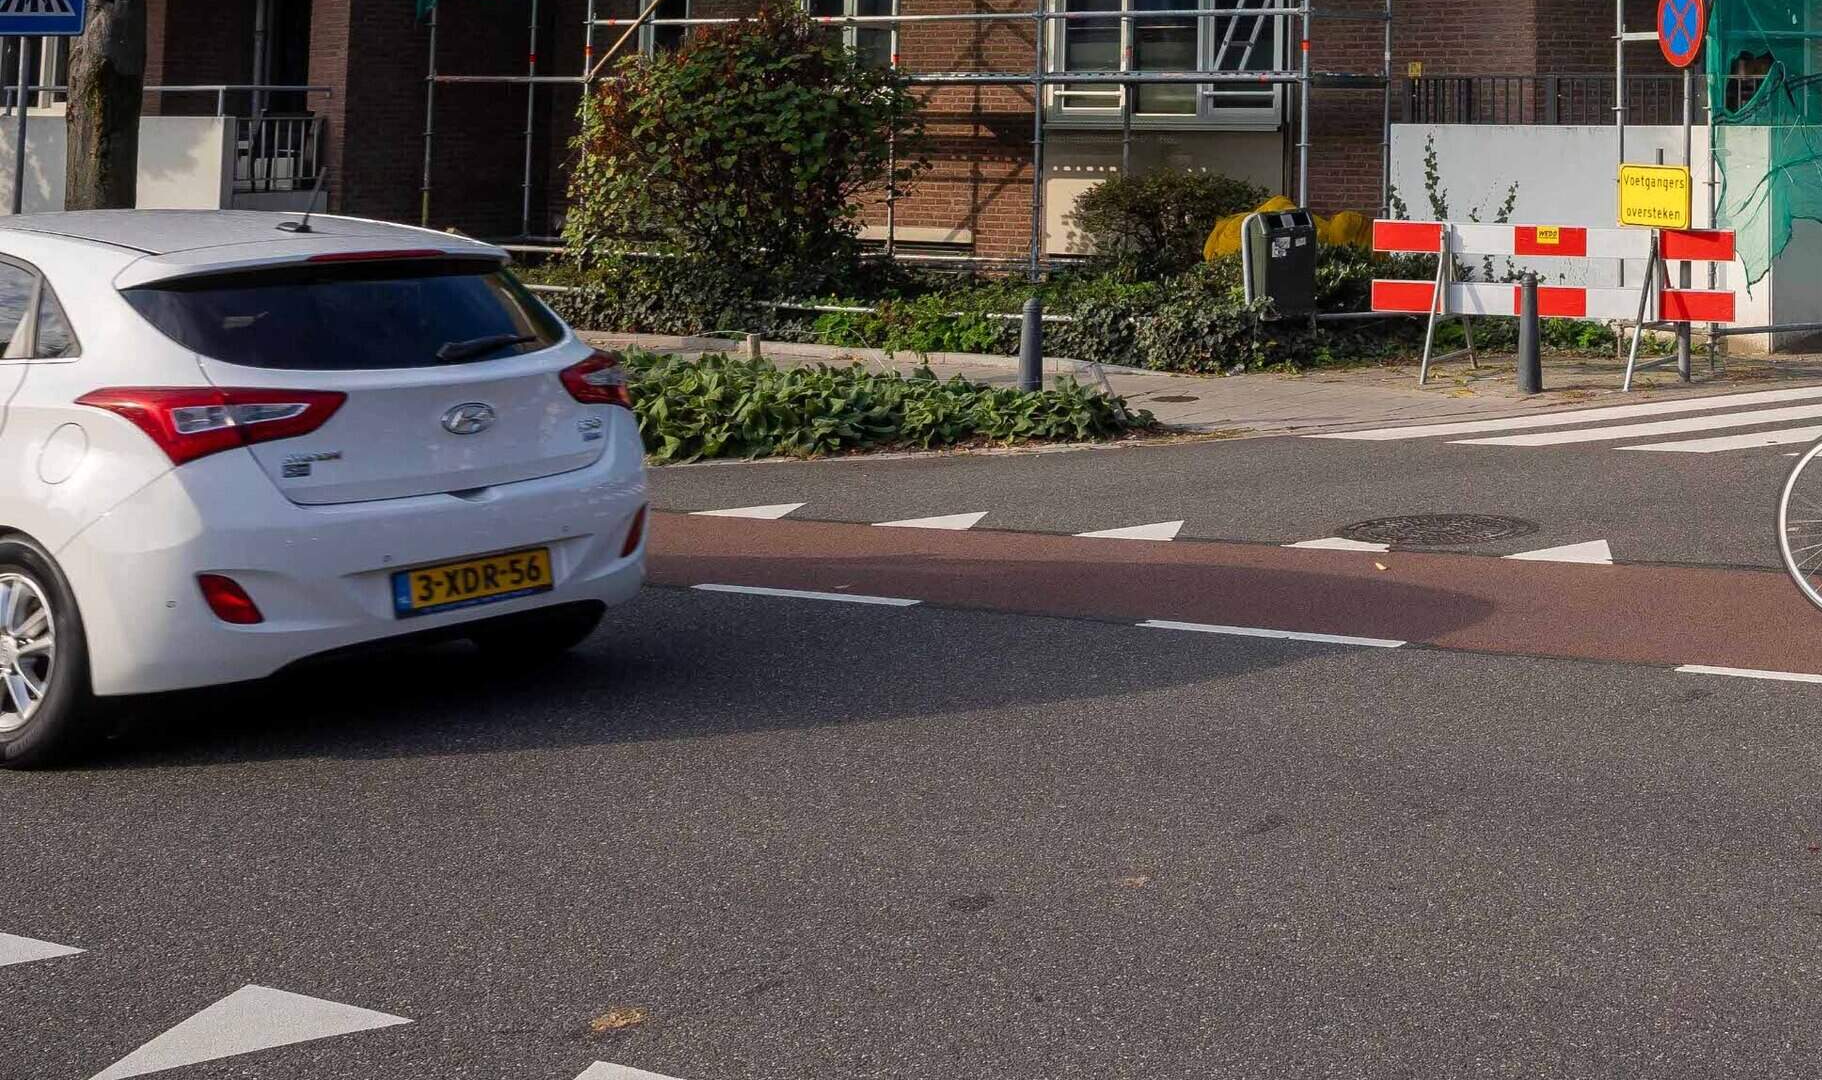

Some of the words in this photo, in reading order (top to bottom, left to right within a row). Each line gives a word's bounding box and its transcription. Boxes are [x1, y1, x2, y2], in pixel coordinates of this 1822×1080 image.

[1623, 174, 1685, 192] Voetgangers
[1626, 207, 1681, 220] oversteken
[416, 555, 542, 602] 3-XDR-56
